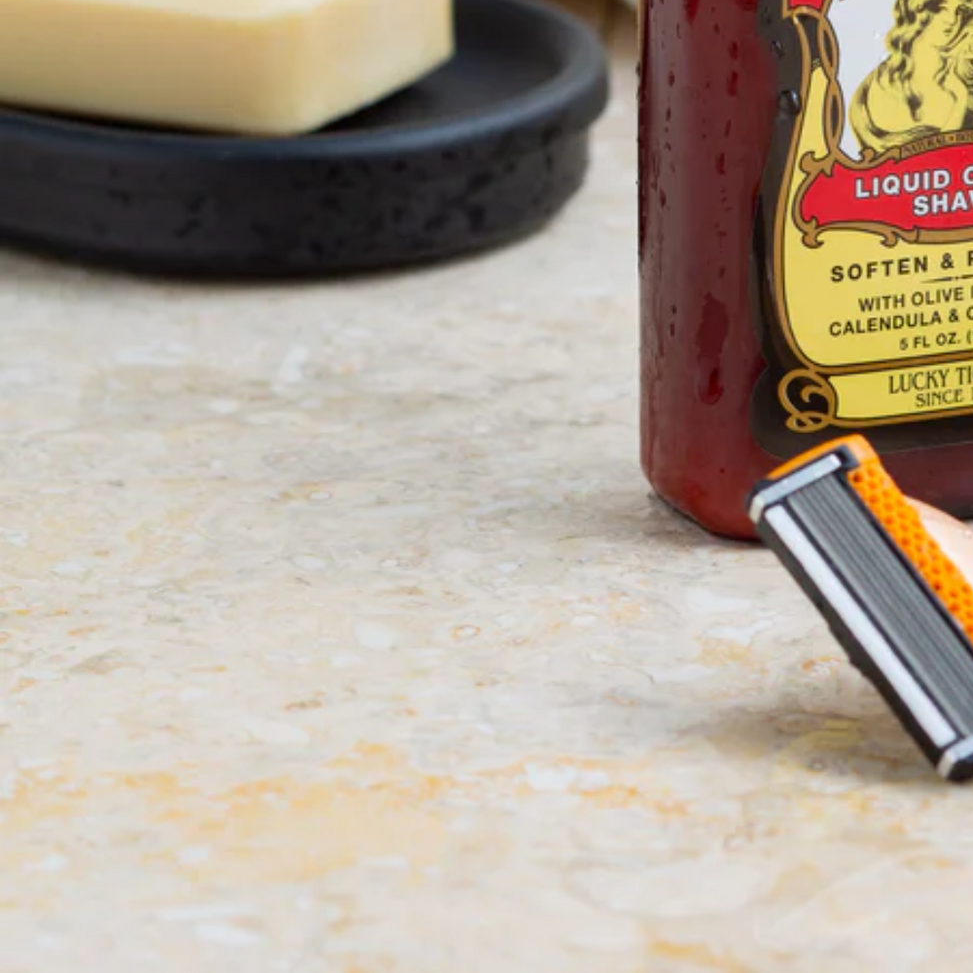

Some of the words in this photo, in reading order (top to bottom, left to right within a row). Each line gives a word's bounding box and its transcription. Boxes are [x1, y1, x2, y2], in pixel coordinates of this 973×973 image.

[854, 167, 951, 200] LIQUID
[830, 256, 929, 283] SOFTEN
[940, 252, 954, 270] &
[858, 293, 906, 313] WITH
[911, 286, 964, 307] OLIVE
[829, 311, 942, 337] CALENDULA
[948, 308, 959, 323] &
[899, 337, 909, 351] 5
[913, 335, 930, 349] FL
[936, 332, 961, 346] OZ.
[888, 369, 950, 395] LUCKY
[915, 388, 964, 408] SINCE
